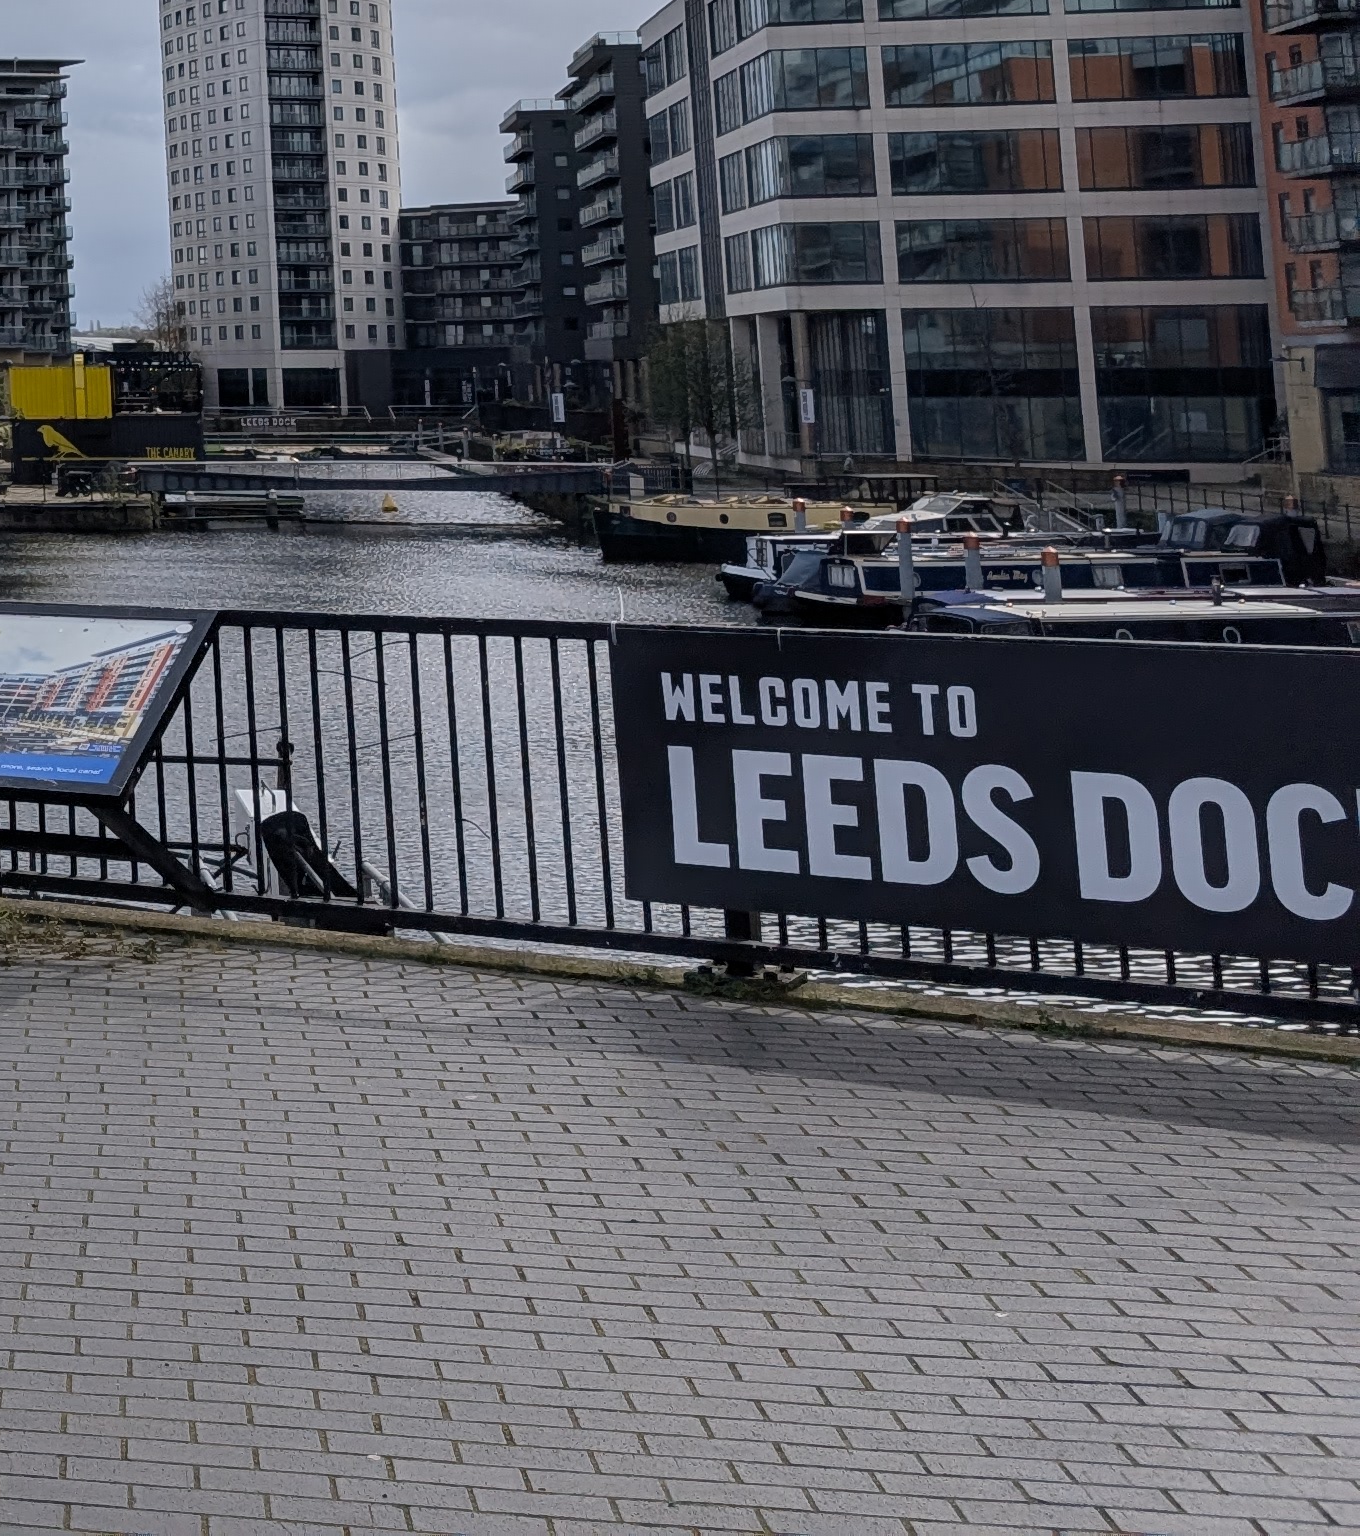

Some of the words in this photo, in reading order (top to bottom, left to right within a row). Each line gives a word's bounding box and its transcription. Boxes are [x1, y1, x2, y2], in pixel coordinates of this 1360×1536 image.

[241, 417, 270, 427] LEEDS
[272, 417, 297, 427] DOCK
[146, 447, 161, 459] THE
[163, 447, 195, 459] CANARY
[660, 672, 892, 734] WELCOME
[911, 683, 978, 739] TO
[667, 745, 1041, 896] LEEDS
[1070, 770, 1360, 921] DOC
